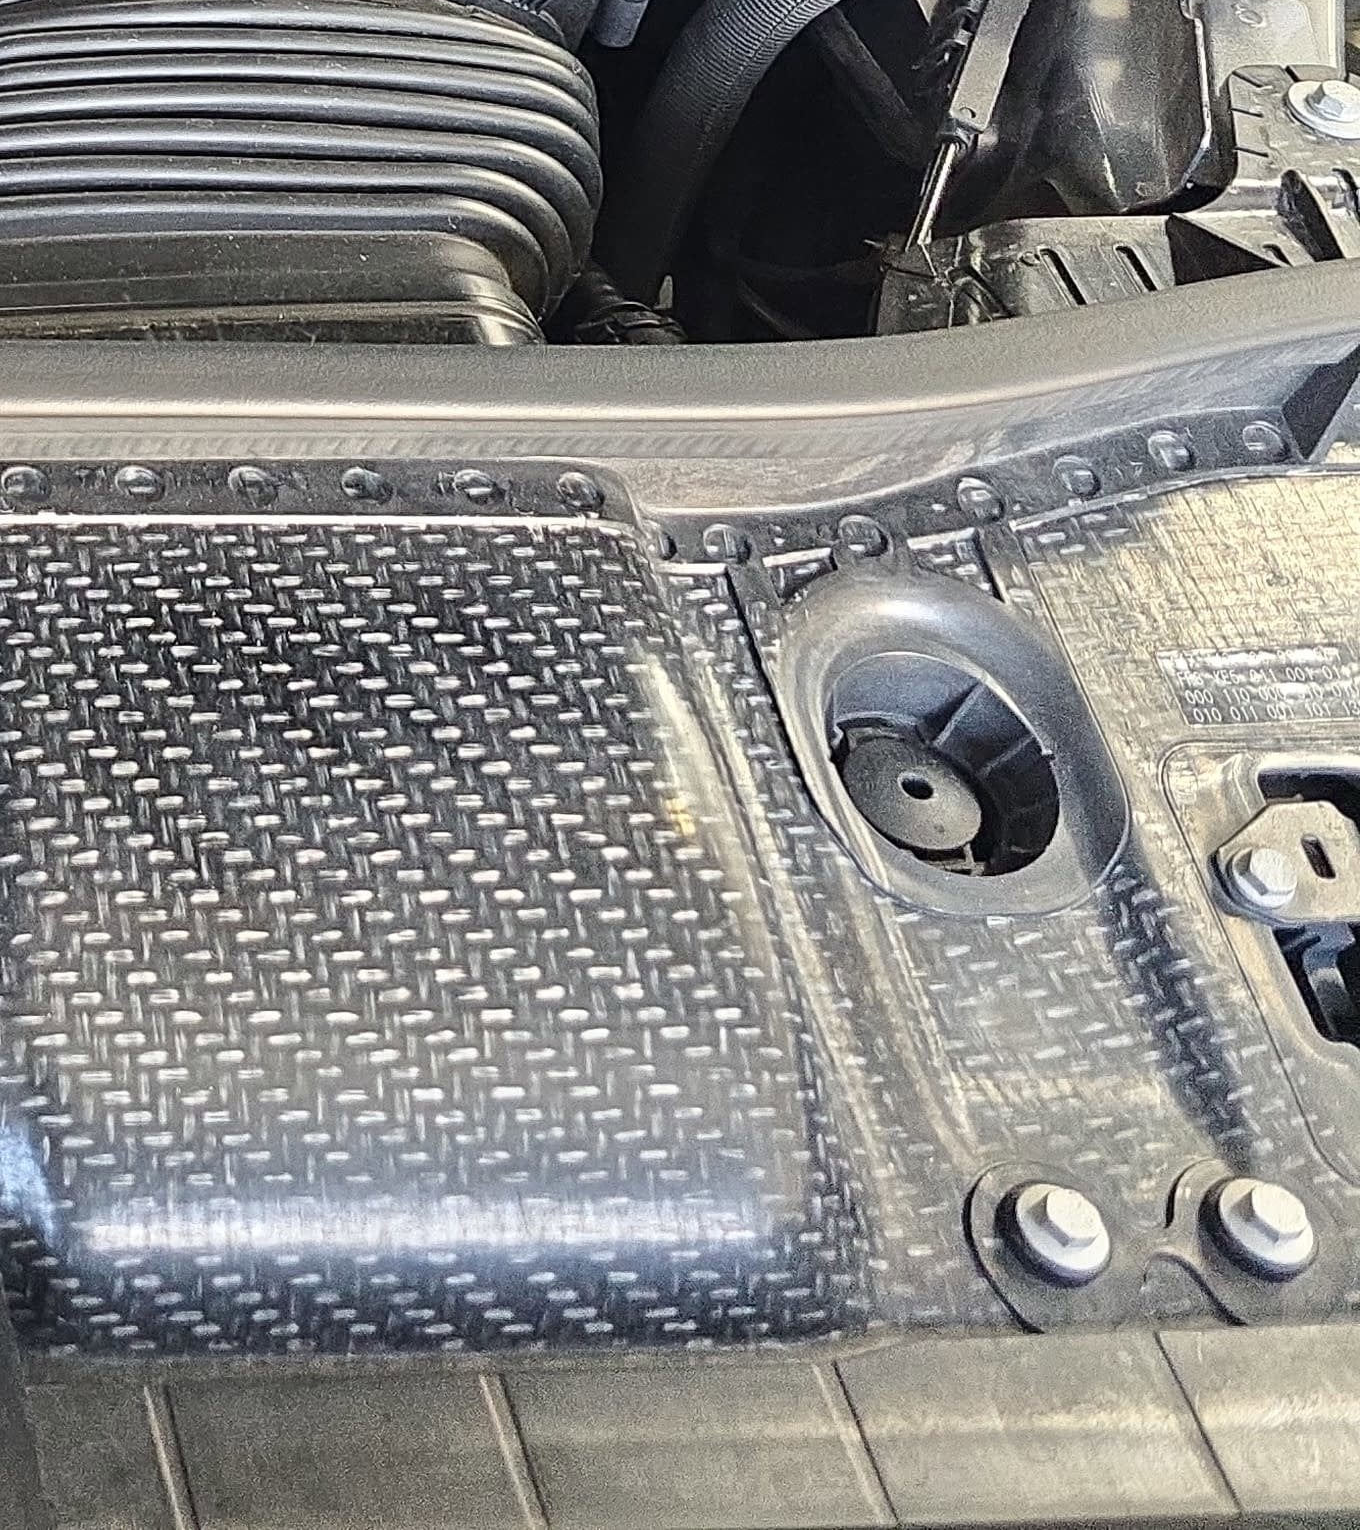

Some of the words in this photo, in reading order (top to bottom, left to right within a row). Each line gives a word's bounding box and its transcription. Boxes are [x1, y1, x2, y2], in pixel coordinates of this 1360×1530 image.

[1184, 689, 1214, 705] 000
[1222, 687, 1251, 704] 110
[1193, 707, 1222, 723] 010
[1230, 705, 1259, 722] 011
[1304, 700, 1332, 718] 101
